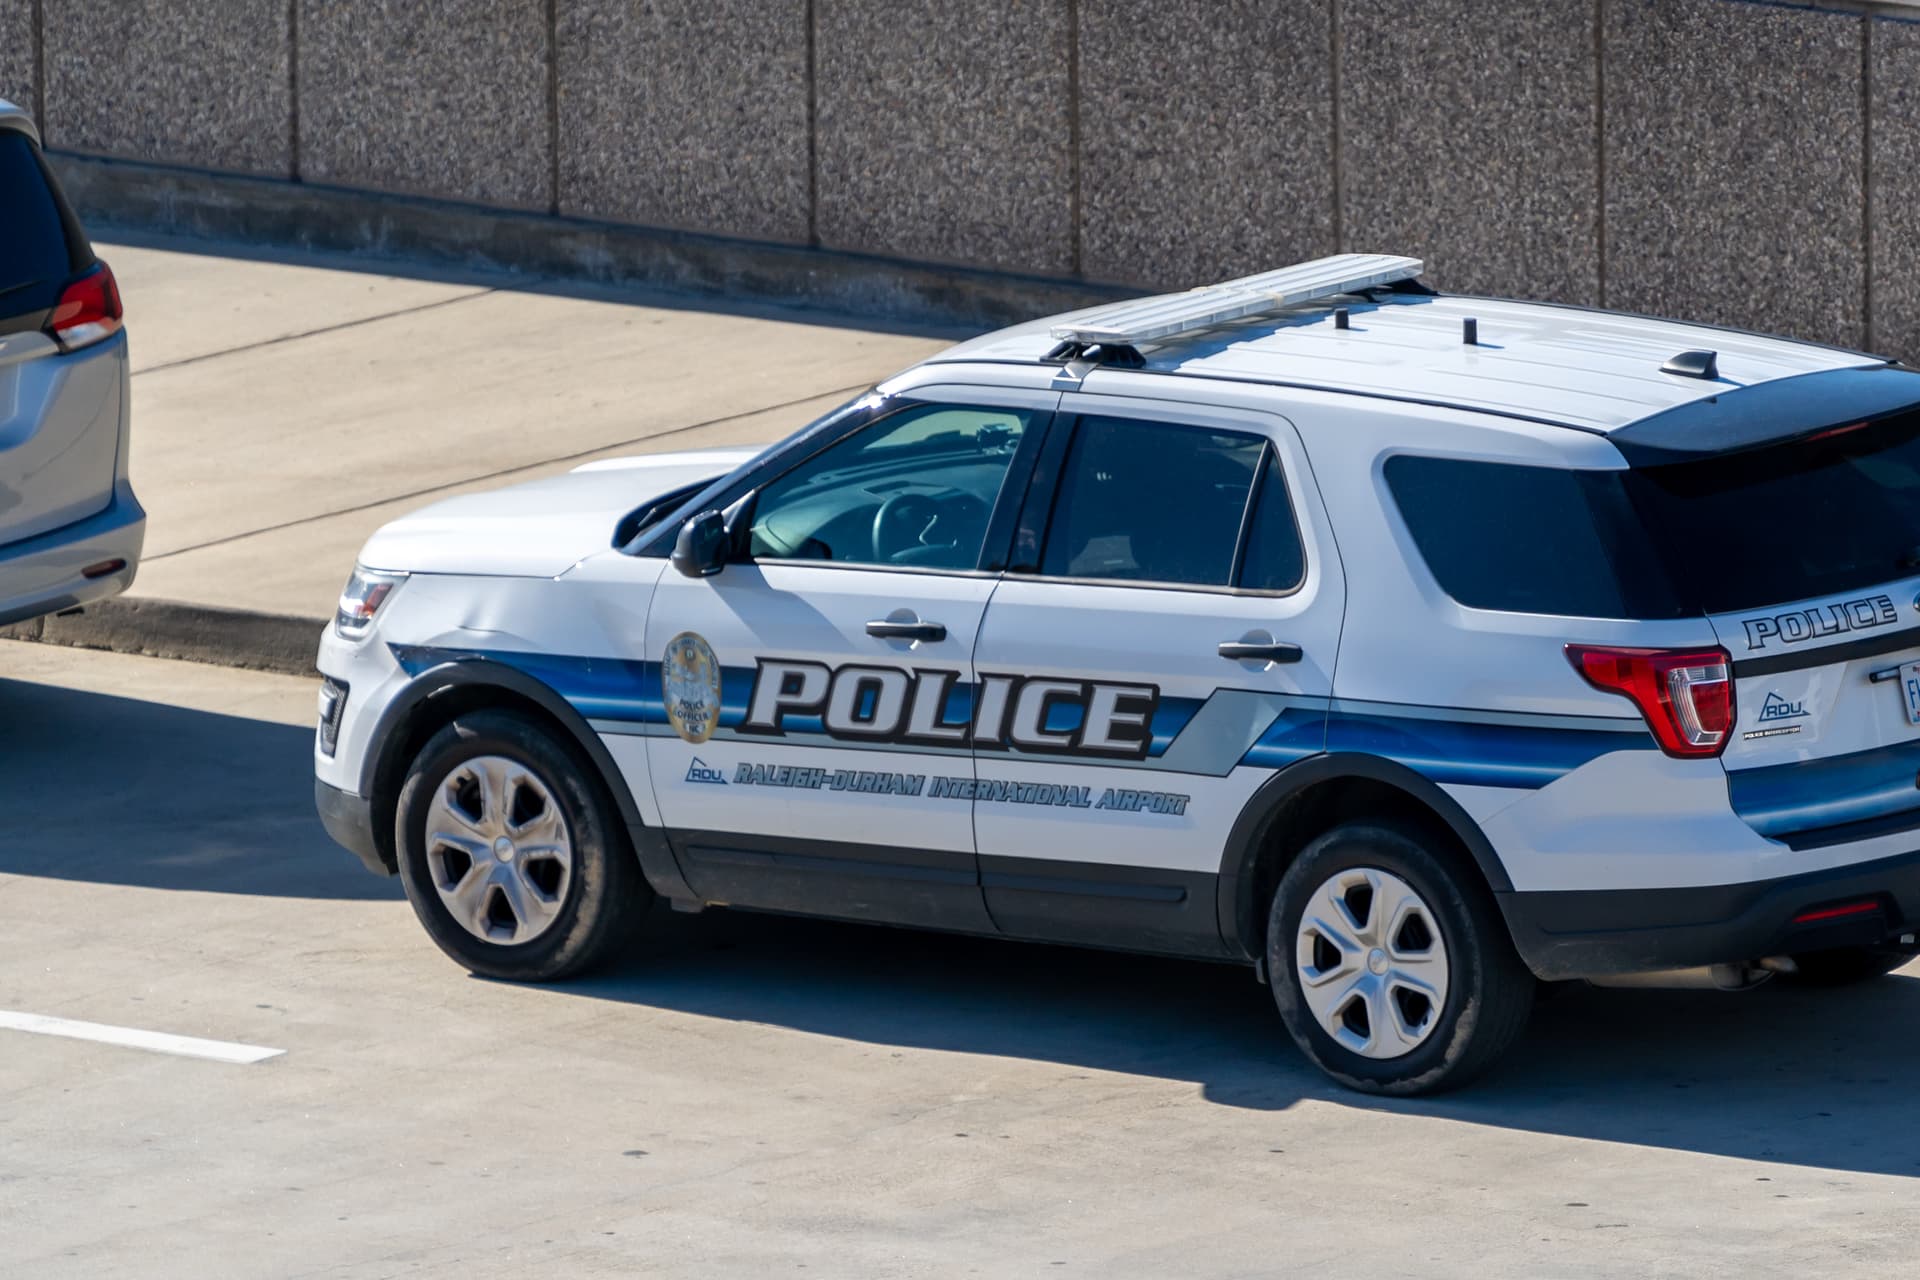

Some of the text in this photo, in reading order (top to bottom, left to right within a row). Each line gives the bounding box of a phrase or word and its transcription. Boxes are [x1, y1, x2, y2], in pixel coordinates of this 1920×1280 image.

[1742, 594, 1898, 650] POLICE
[680, 699, 705, 710] POLICE
[1906, 678, 1920, 710] F
[678, 710, 709, 721] OFFICER
[736, 656, 1160, 760] POLICE
[1765, 702, 1802, 717] RDU
[692, 769, 721, 780] RDU
[733, 762, 1191, 816] RALEIGH-DURHAM INTERNATIONAL AIRPORT
